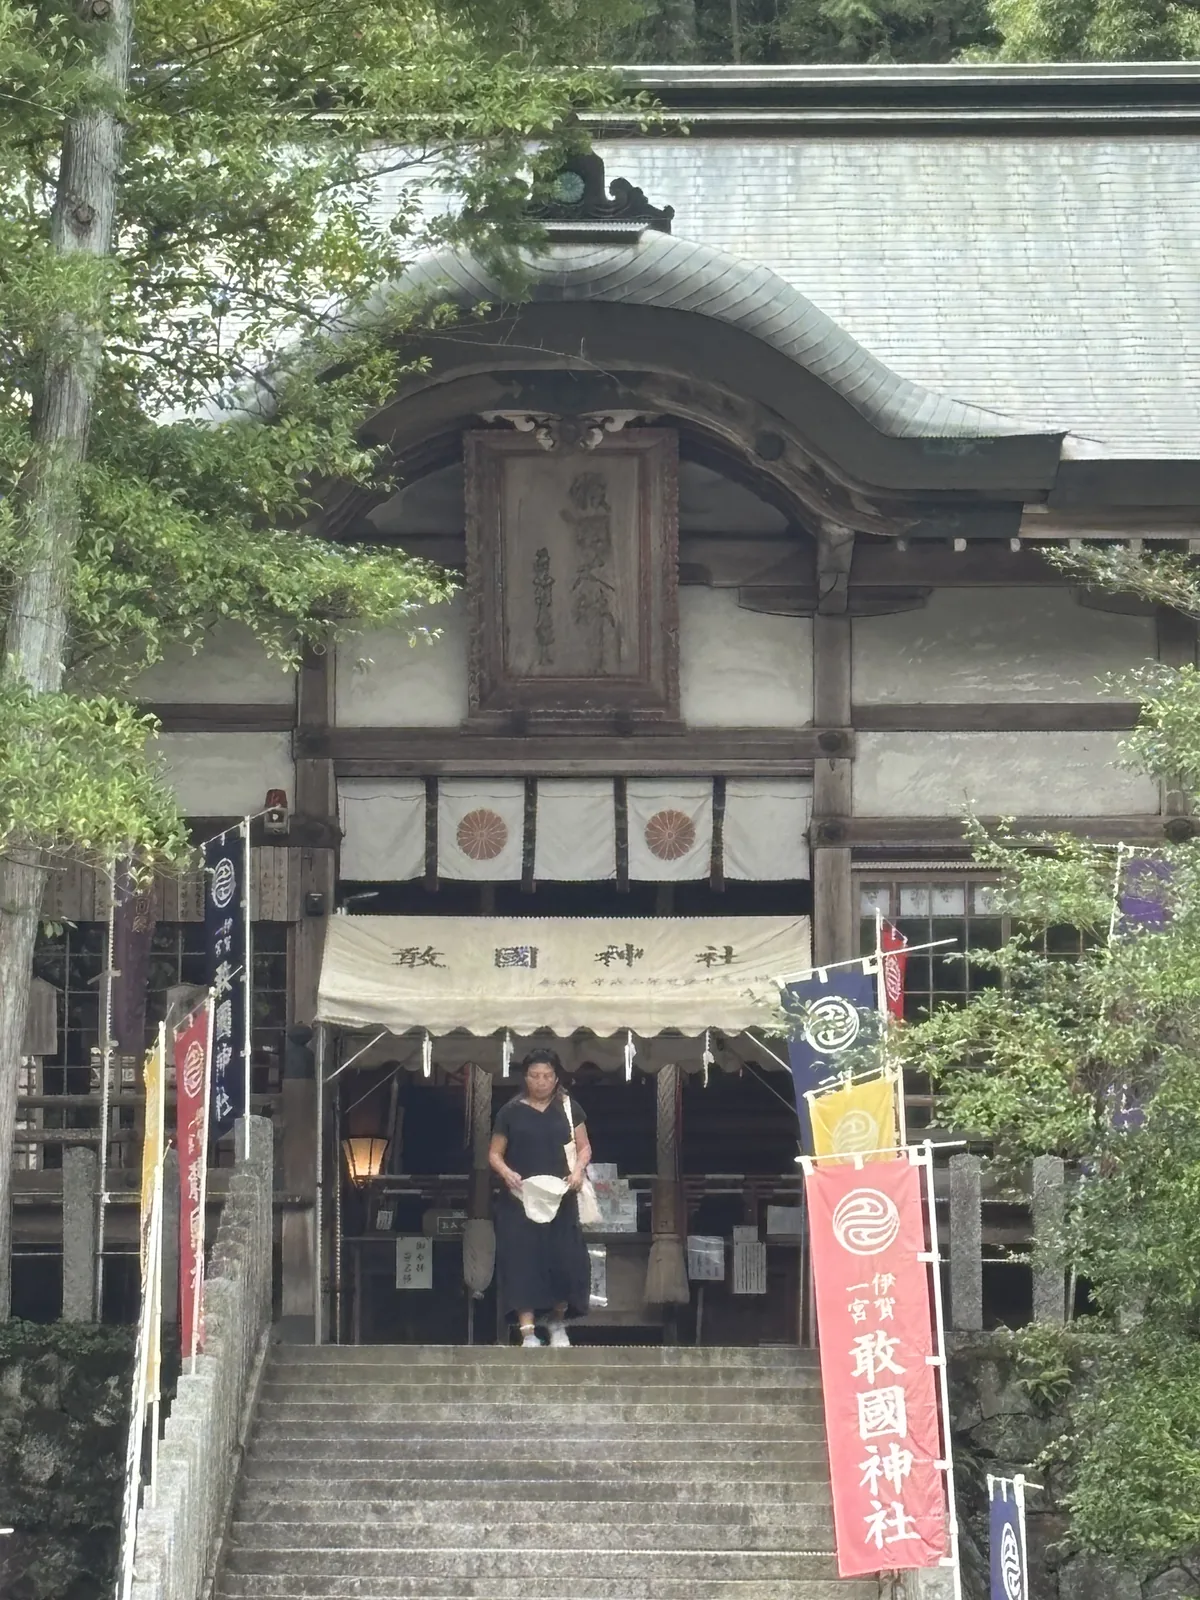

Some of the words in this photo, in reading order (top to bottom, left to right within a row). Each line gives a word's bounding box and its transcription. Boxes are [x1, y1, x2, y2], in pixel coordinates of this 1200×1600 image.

[391, 943, 738, 969] 敢國神社
[846, 1283, 869, 1324] 一宮
[872, 1271, 896, 1321] 伊賀
[849, 1330, 921, 1549] 敢國神社
